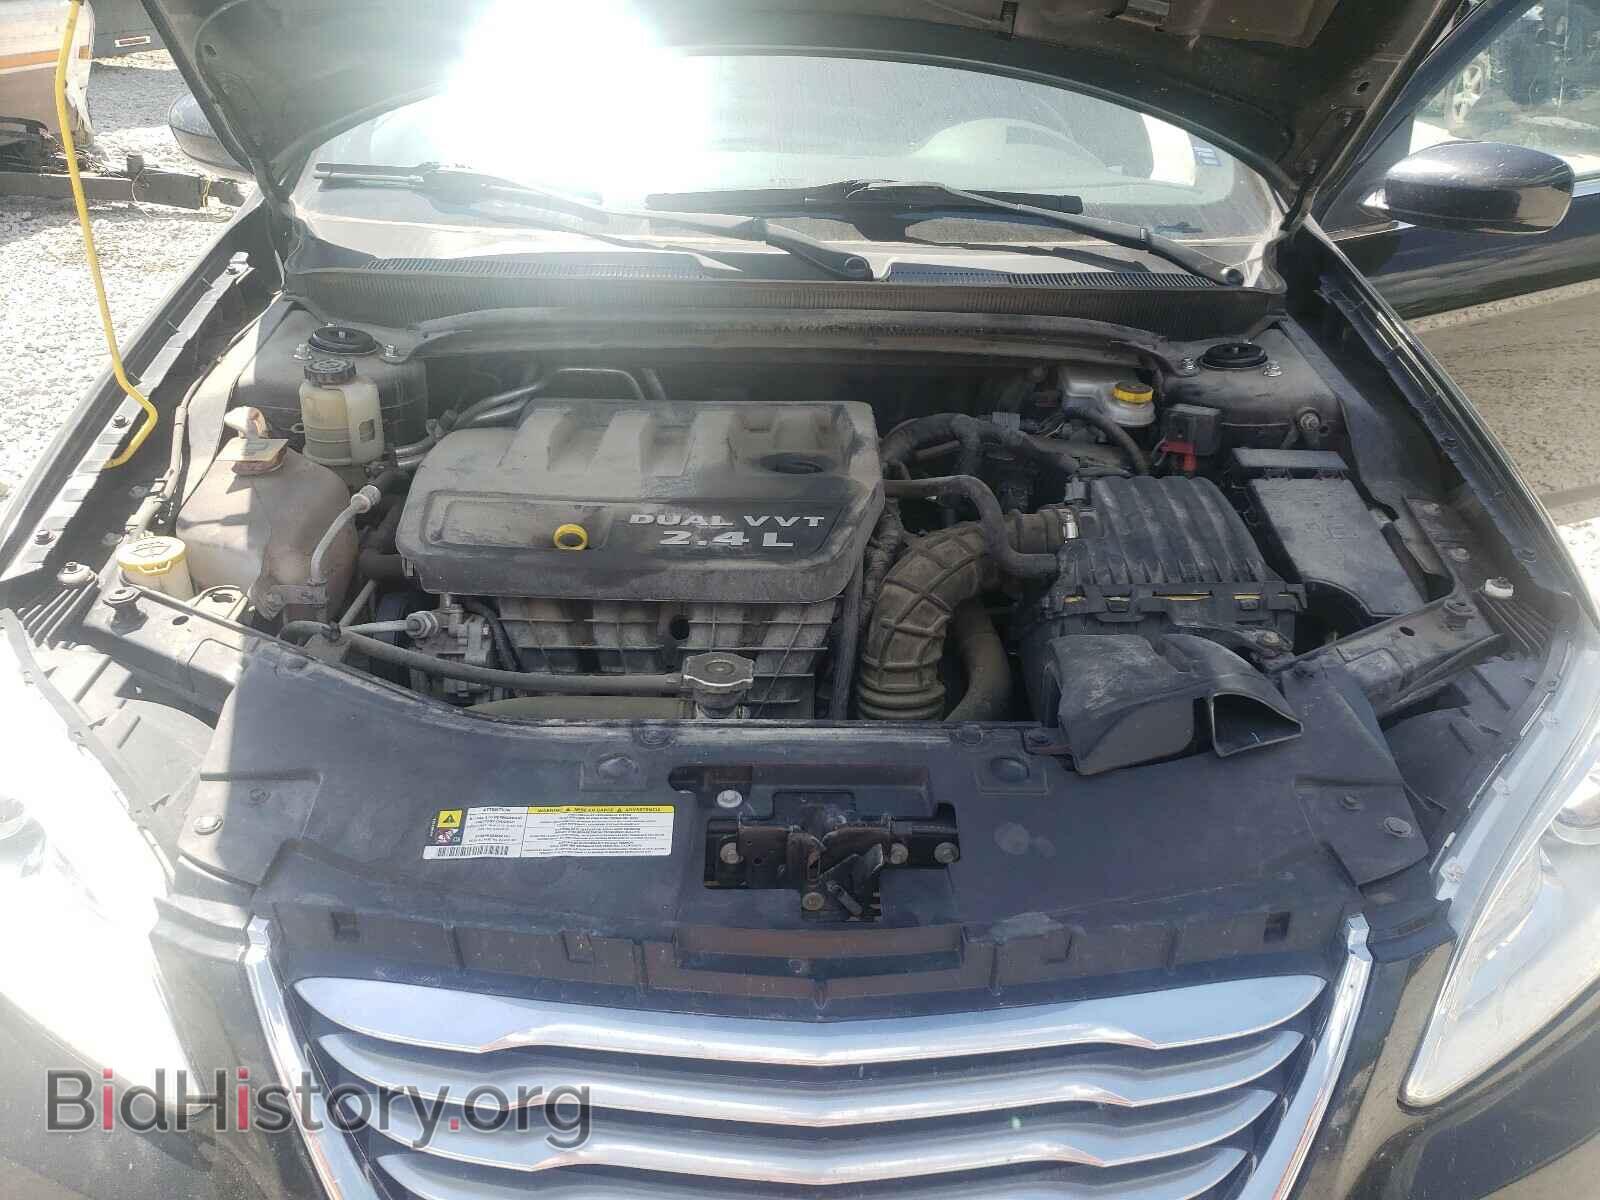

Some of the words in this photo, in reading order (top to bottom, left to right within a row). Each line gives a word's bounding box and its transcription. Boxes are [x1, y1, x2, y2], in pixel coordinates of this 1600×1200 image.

[629, 513, 735, 528] DUAL
[743, 515, 825, 528] VVT
[659, 530, 750, 547] 2.4
[762, 532, 795, 547] L
